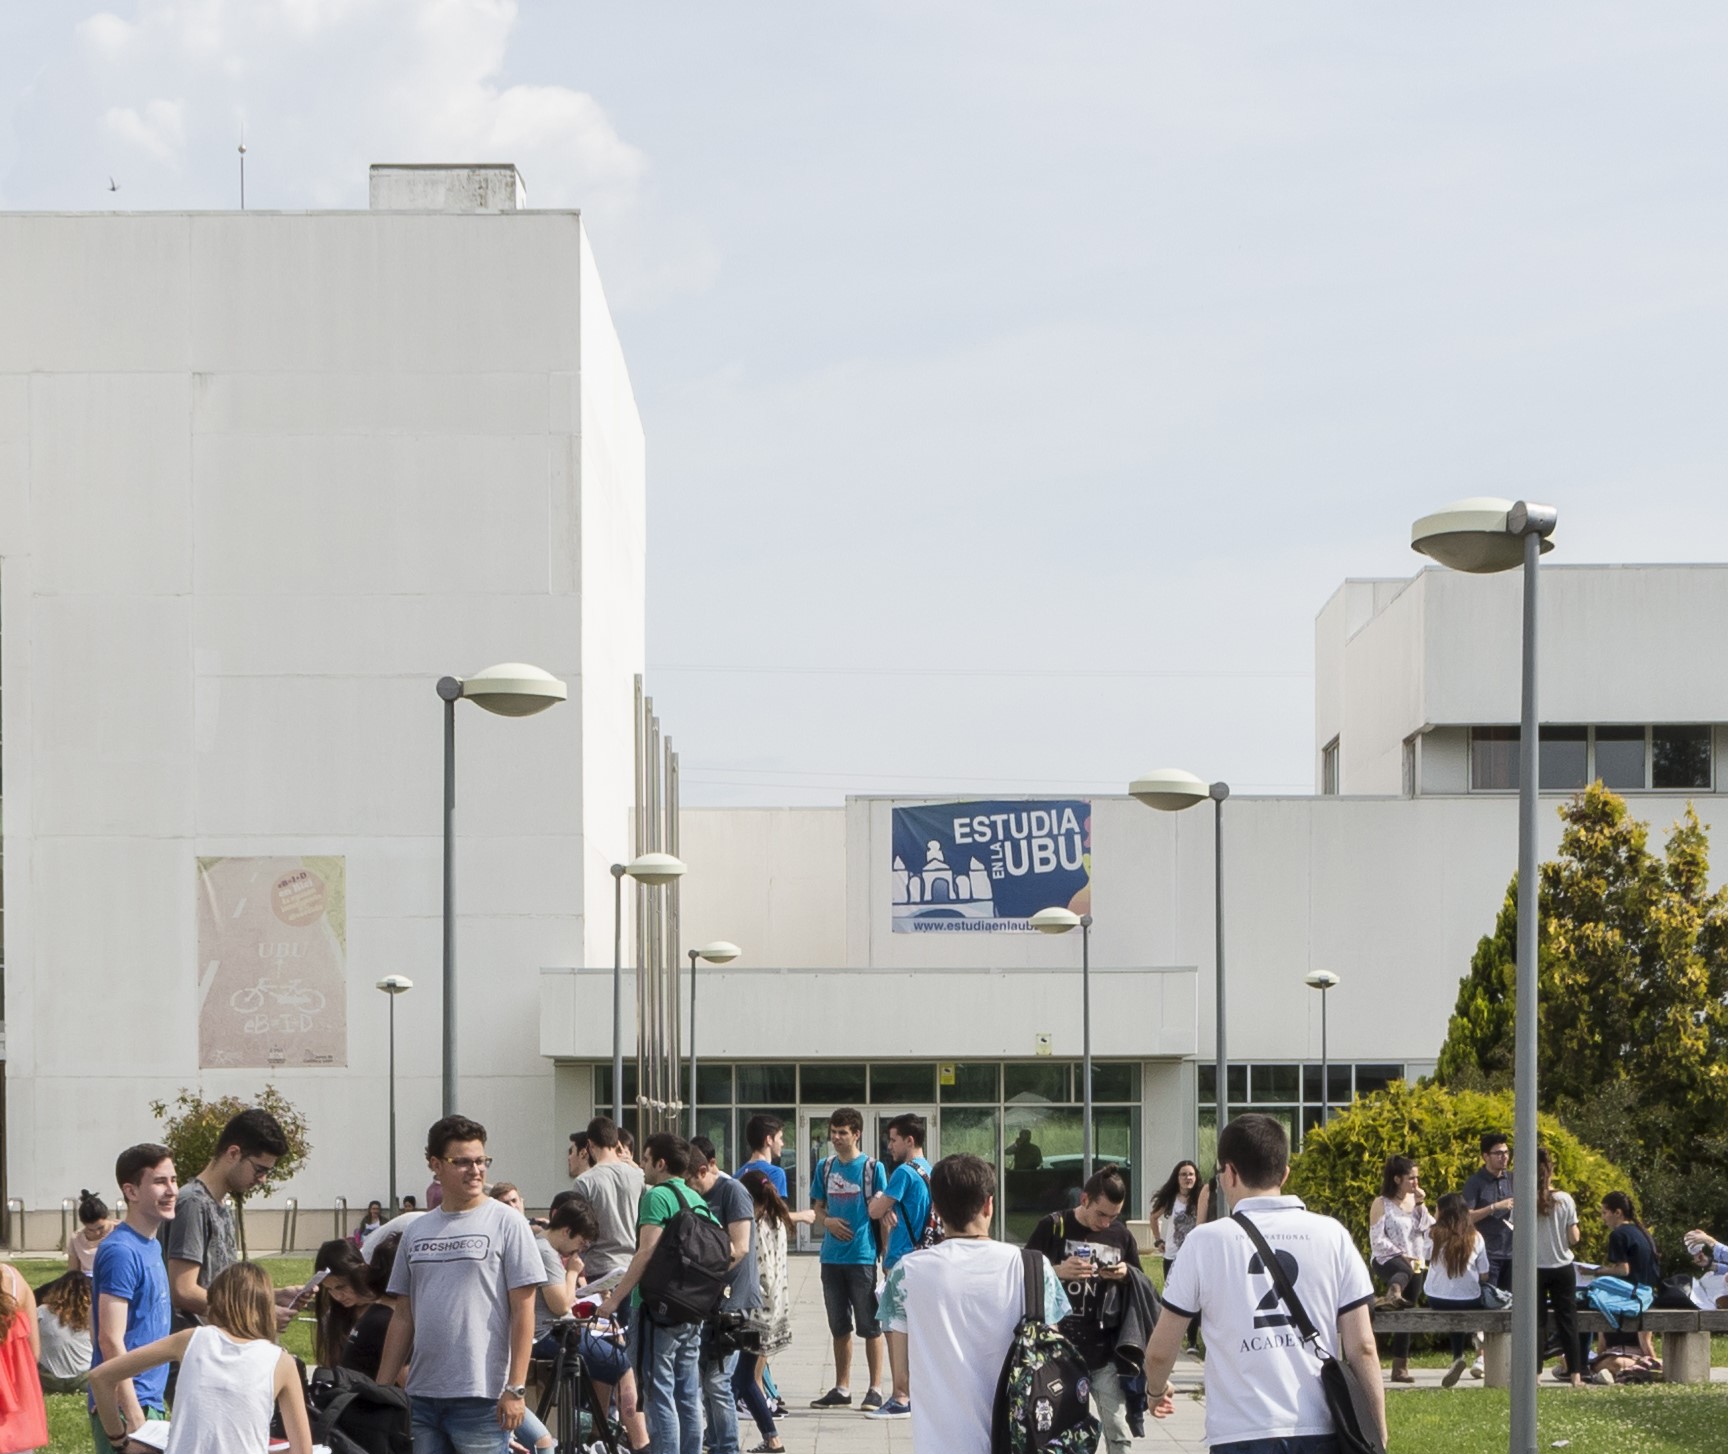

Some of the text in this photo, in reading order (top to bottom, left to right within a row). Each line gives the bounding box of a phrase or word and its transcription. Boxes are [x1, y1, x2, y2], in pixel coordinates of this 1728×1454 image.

[953, 807, 1081, 845] ESTUDIA
[990, 841, 1005, 879] EN LA
[1004, 833, 1083, 876] UBU
[913, 920, 1039, 933] www.estudiaenlaub
[1235, 1233, 1311, 1242] INNATIONAL
[1247, 1249, 1299, 1329] 2
